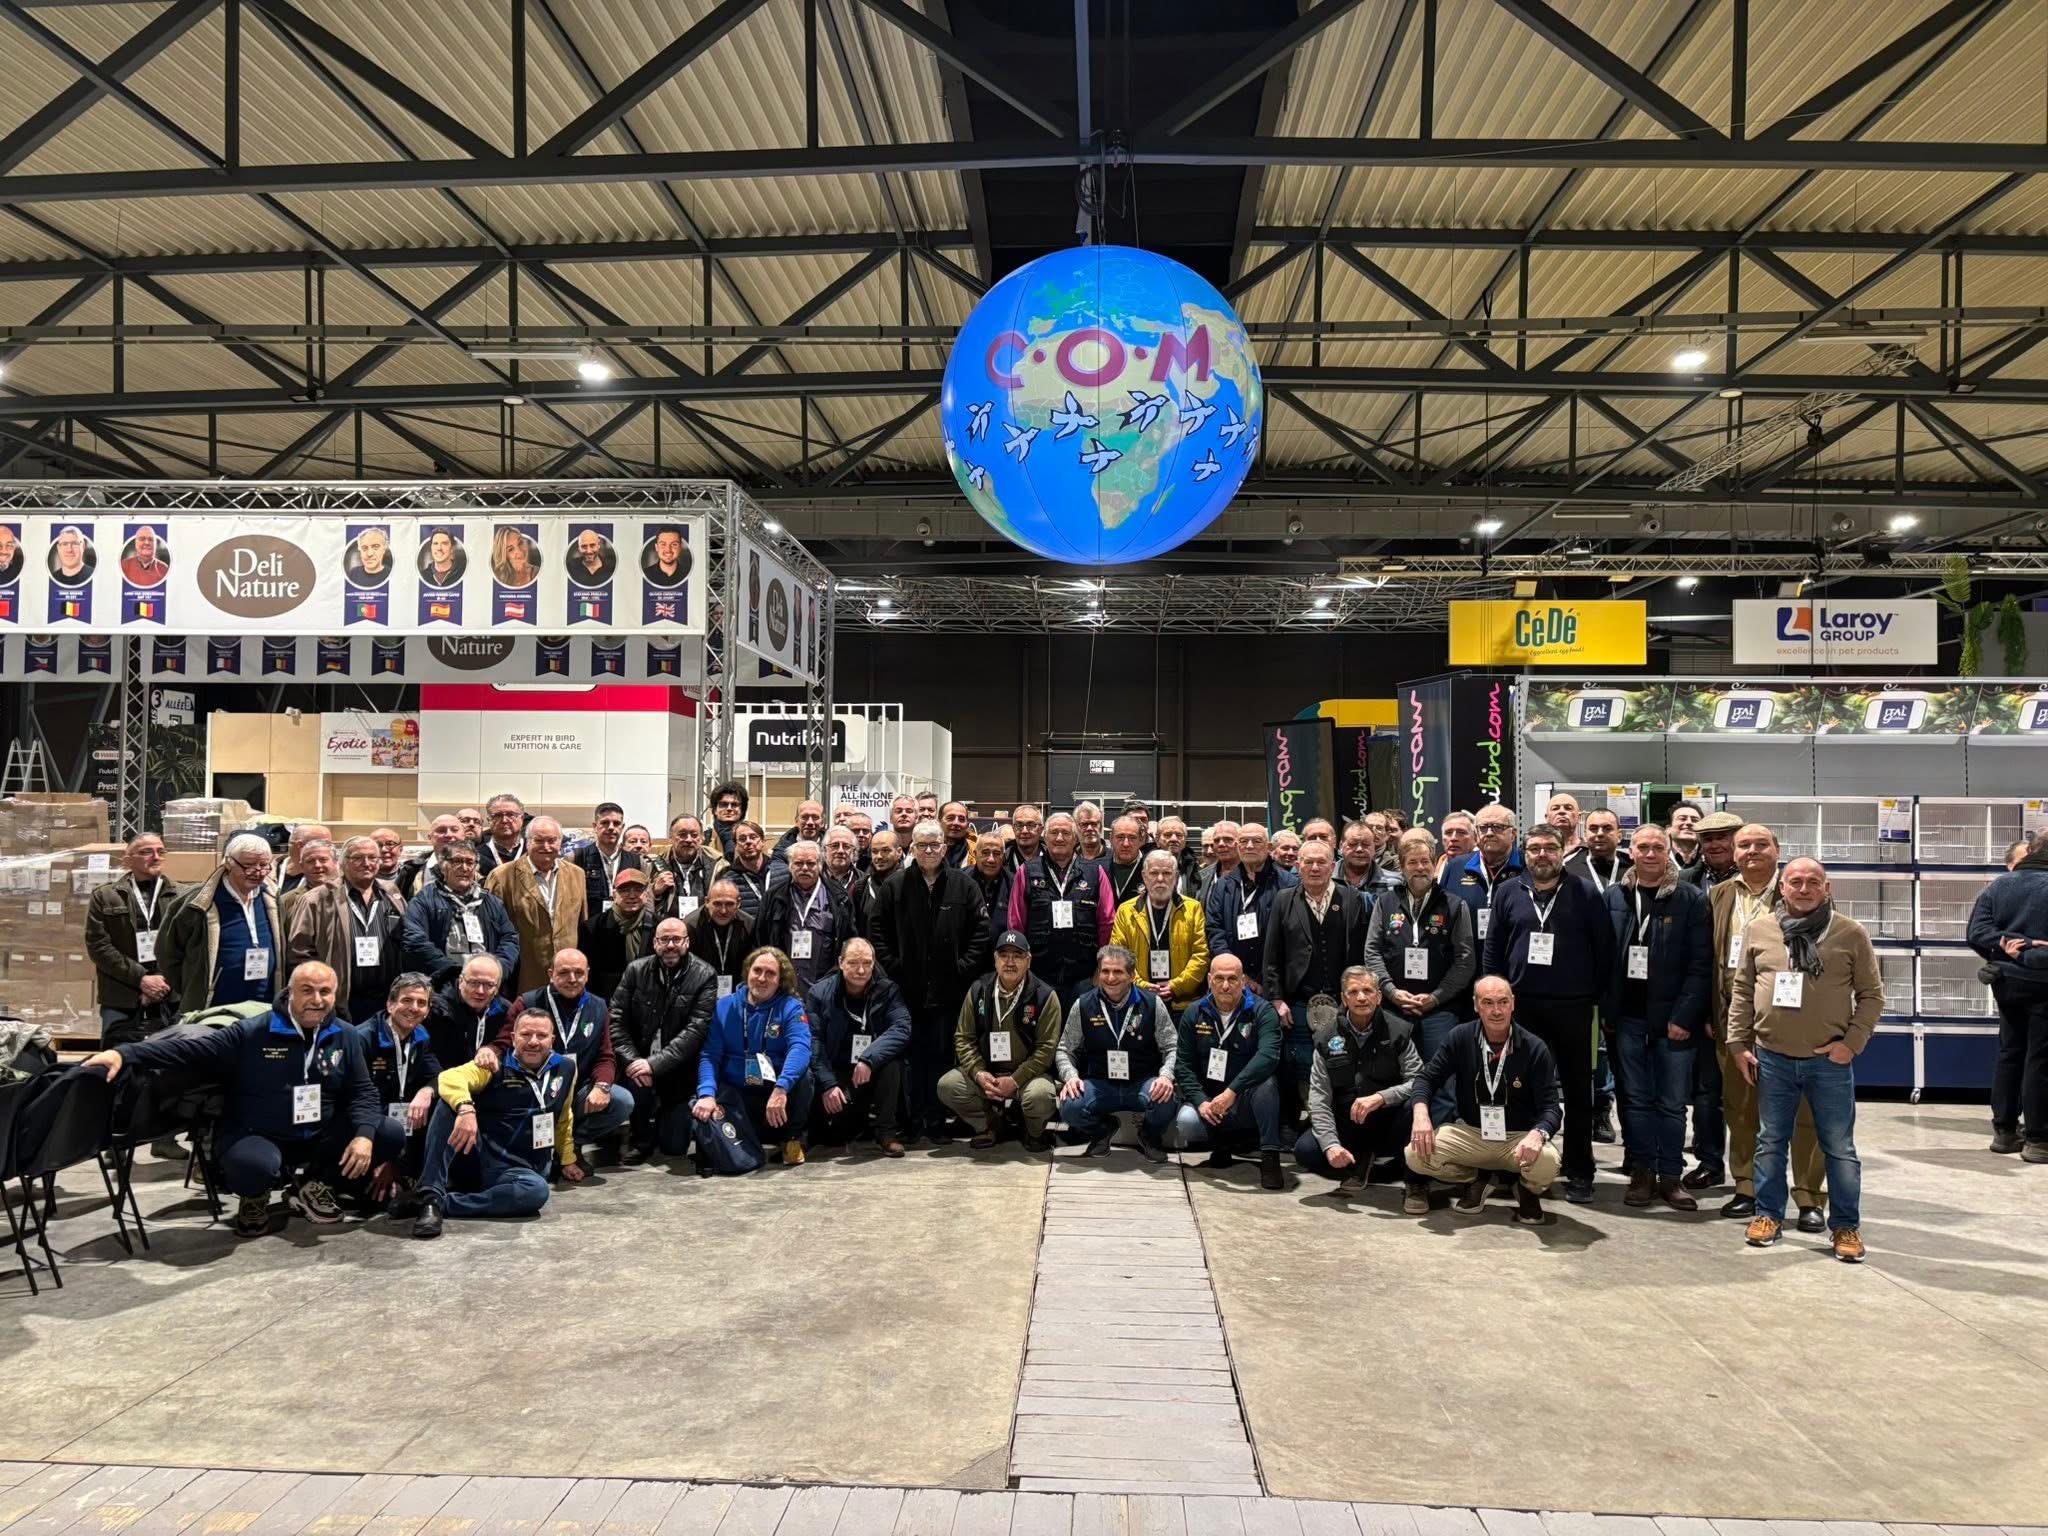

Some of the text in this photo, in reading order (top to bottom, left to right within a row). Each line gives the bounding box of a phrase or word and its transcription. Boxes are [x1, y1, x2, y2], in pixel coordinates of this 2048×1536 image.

[229, 548, 284, 577] Deli
[215, 568, 300, 598] Nature
[1515, 607, 1577, 647] CéDé
[1820, 607, 1893, 635] Laroy
[1820, 630, 1875, 642] GROUP
[441, 635, 504, 656] Nature
[1839, 647, 1855, 656] pet
[1857, 647, 1899, 656] products
[510, 734, 576, 742] EXPERT IN BIRD
[327, 736, 368, 753] Exotic
[503, 742, 582, 750] NUTRITION & CARE
[840, 784, 859, 792] THE
[840, 792, 894, 800] ALL-IN-ONE
[841, 800, 892, 808] TRITION
